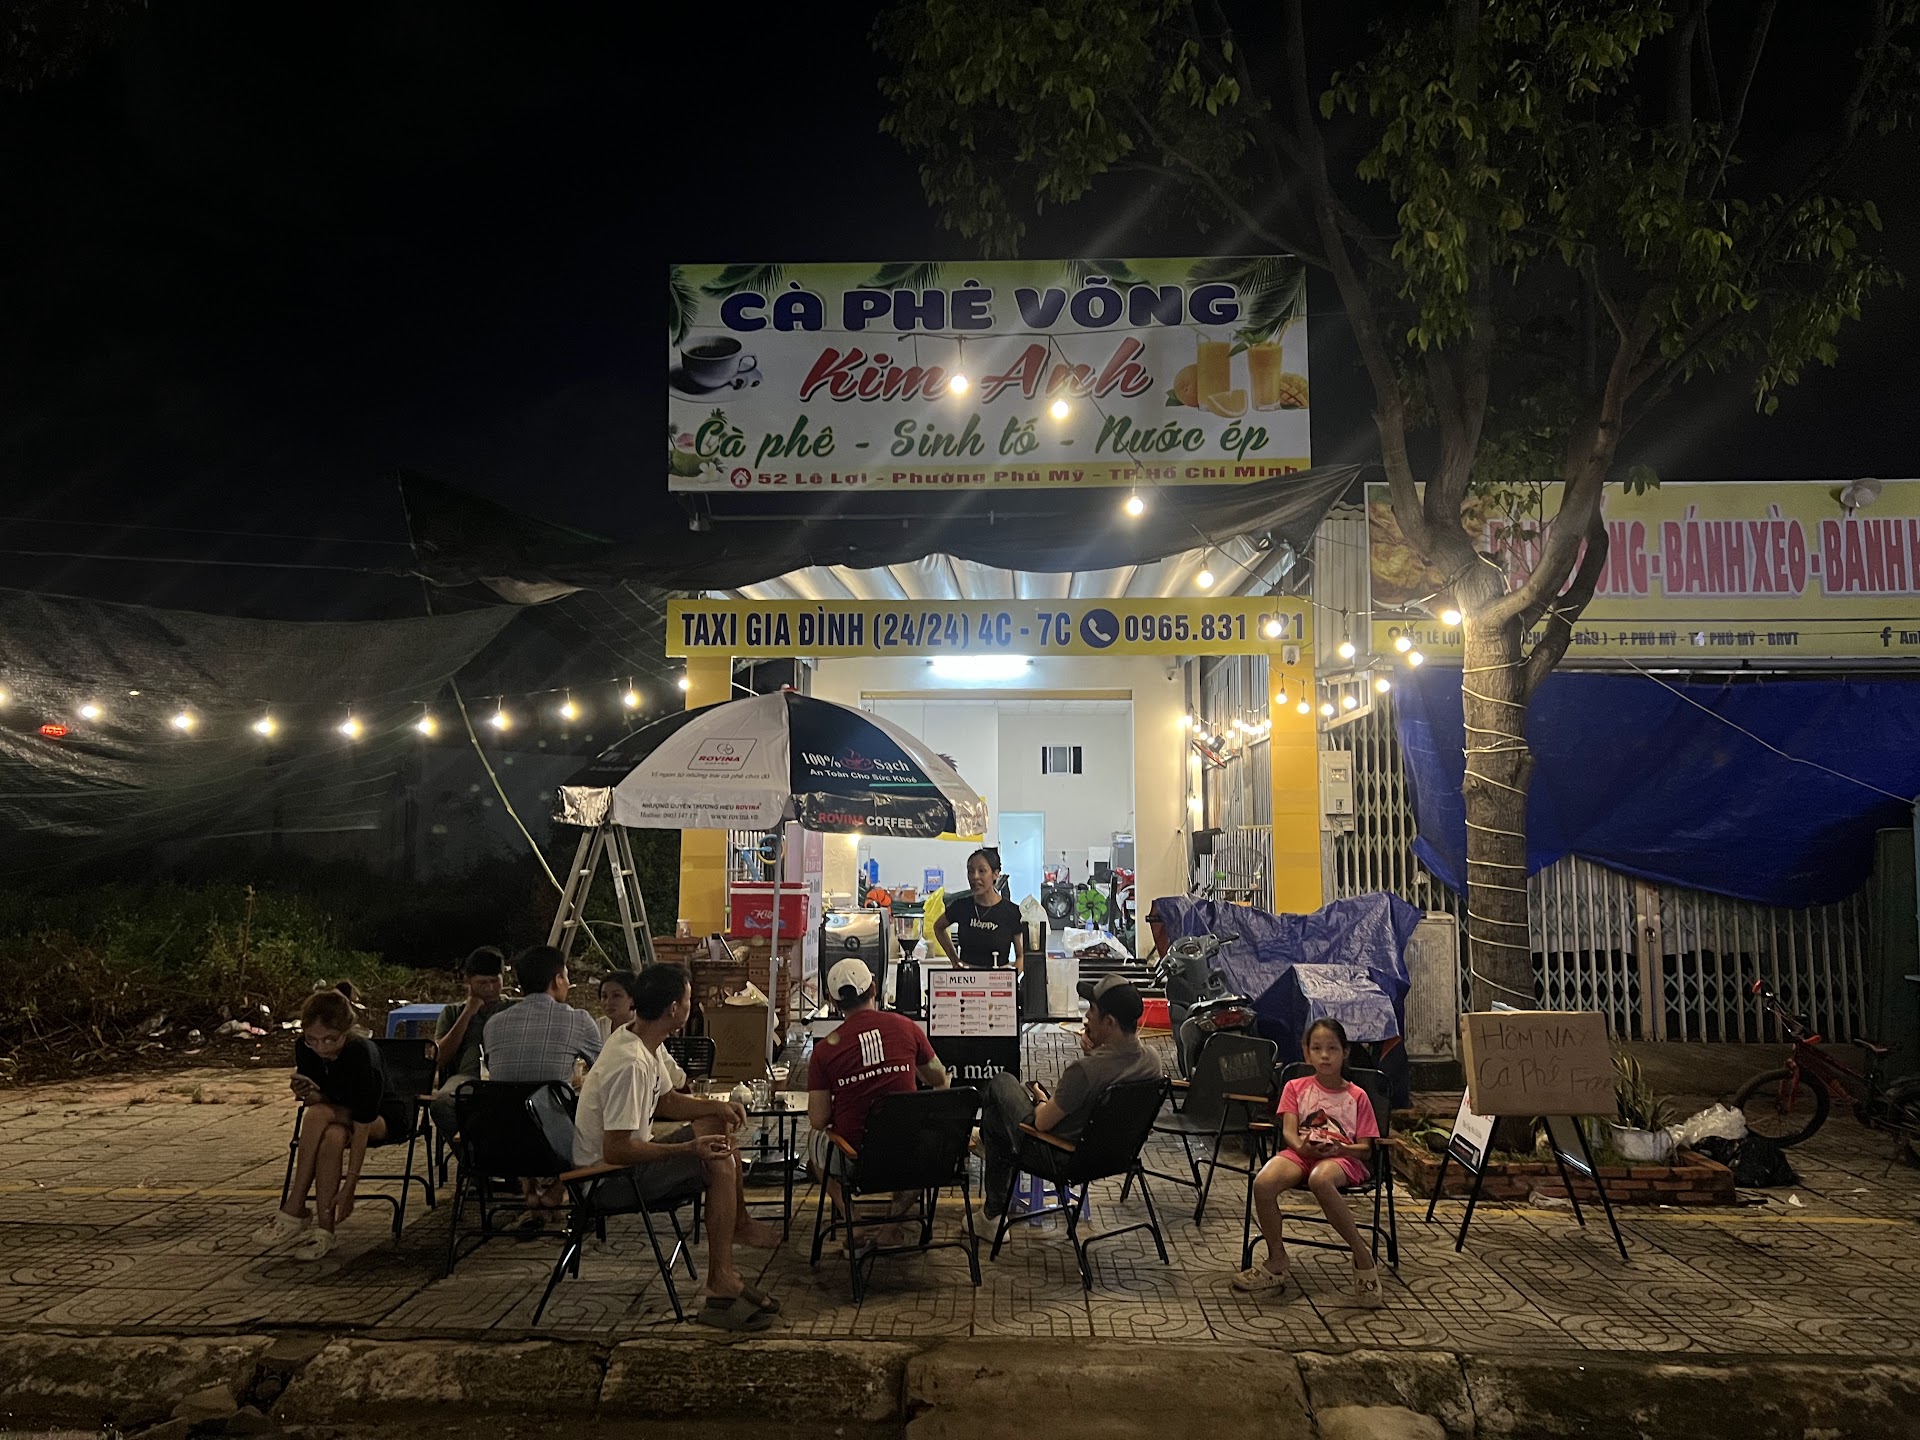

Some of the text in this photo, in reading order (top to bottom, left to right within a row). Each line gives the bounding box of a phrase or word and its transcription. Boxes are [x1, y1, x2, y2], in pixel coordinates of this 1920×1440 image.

[720, 276, 1240, 332] CÀ PHÊ VÕNG
[799, 336, 1153, 401] Kim Anh
[695, 420, 746, 458] Cà
[754, 414, 835, 469] phê
[890, 413, 985, 457] Sinh
[999, 415, 1039, 456] tố
[1095, 414, 1205, 454] Nước
[1219, 419, 1270, 462] ép
[758, 473, 788, 484] 52
[795, 472, 823, 485] Lê
[830, 472, 867, 486] Lợi
[892, 471, 986, 486] Phường
[993, 469, 1040, 482] Phú
[1049, 468, 1084, 483] Mỹ
[1184, 466, 1226, 479] Chí
[1234, 464, 1299, 478] Minh
[681, 613, 737, 646] TAXI
[746, 613, 791, 646] GIA
[798, 605, 864, 646] ĐÌNH
[873, 612, 970, 650] (24/24)
[978, 613, 1012, 646] 4C
[1037, 612, 1071, 646] 7C
[1125, 613, 1247, 641] 0965.831
[801, 752, 911, 774] 100% Sạch
[809, 768, 824, 777] An
[824, 769, 849, 779] Toàn
[850, 771, 871, 780] Cho
[818, 812, 865, 825] ROVINA
[866, 815, 913, 829] COFFEE
[969, 917, 999, 931] Happy
[949, 976, 976, 985] MENU
[1480, 1022, 1590, 1051] HÔM NAY
